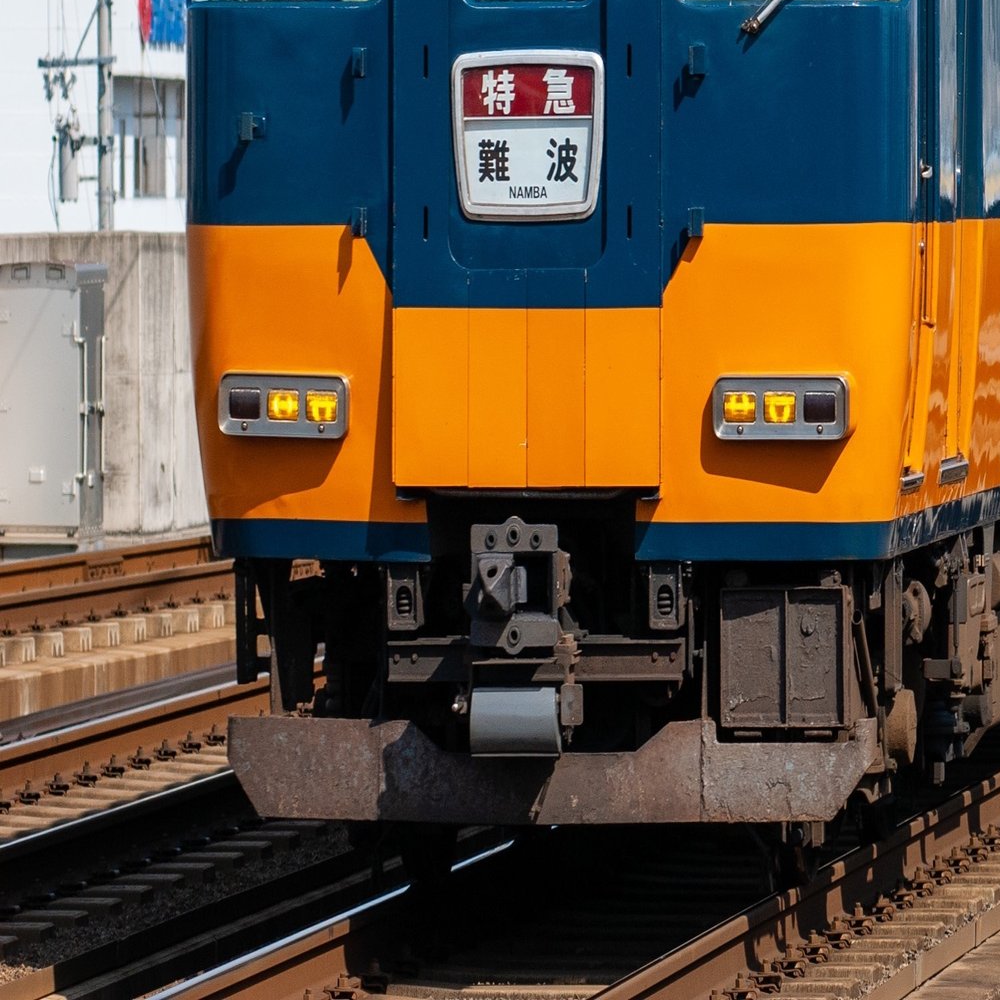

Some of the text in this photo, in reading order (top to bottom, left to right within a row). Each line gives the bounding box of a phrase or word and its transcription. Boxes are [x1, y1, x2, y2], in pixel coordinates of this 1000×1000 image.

[481, 69, 576, 115] 特急
[478, 137, 579, 183] 難波
[508, 186, 548, 199] NAMBA
